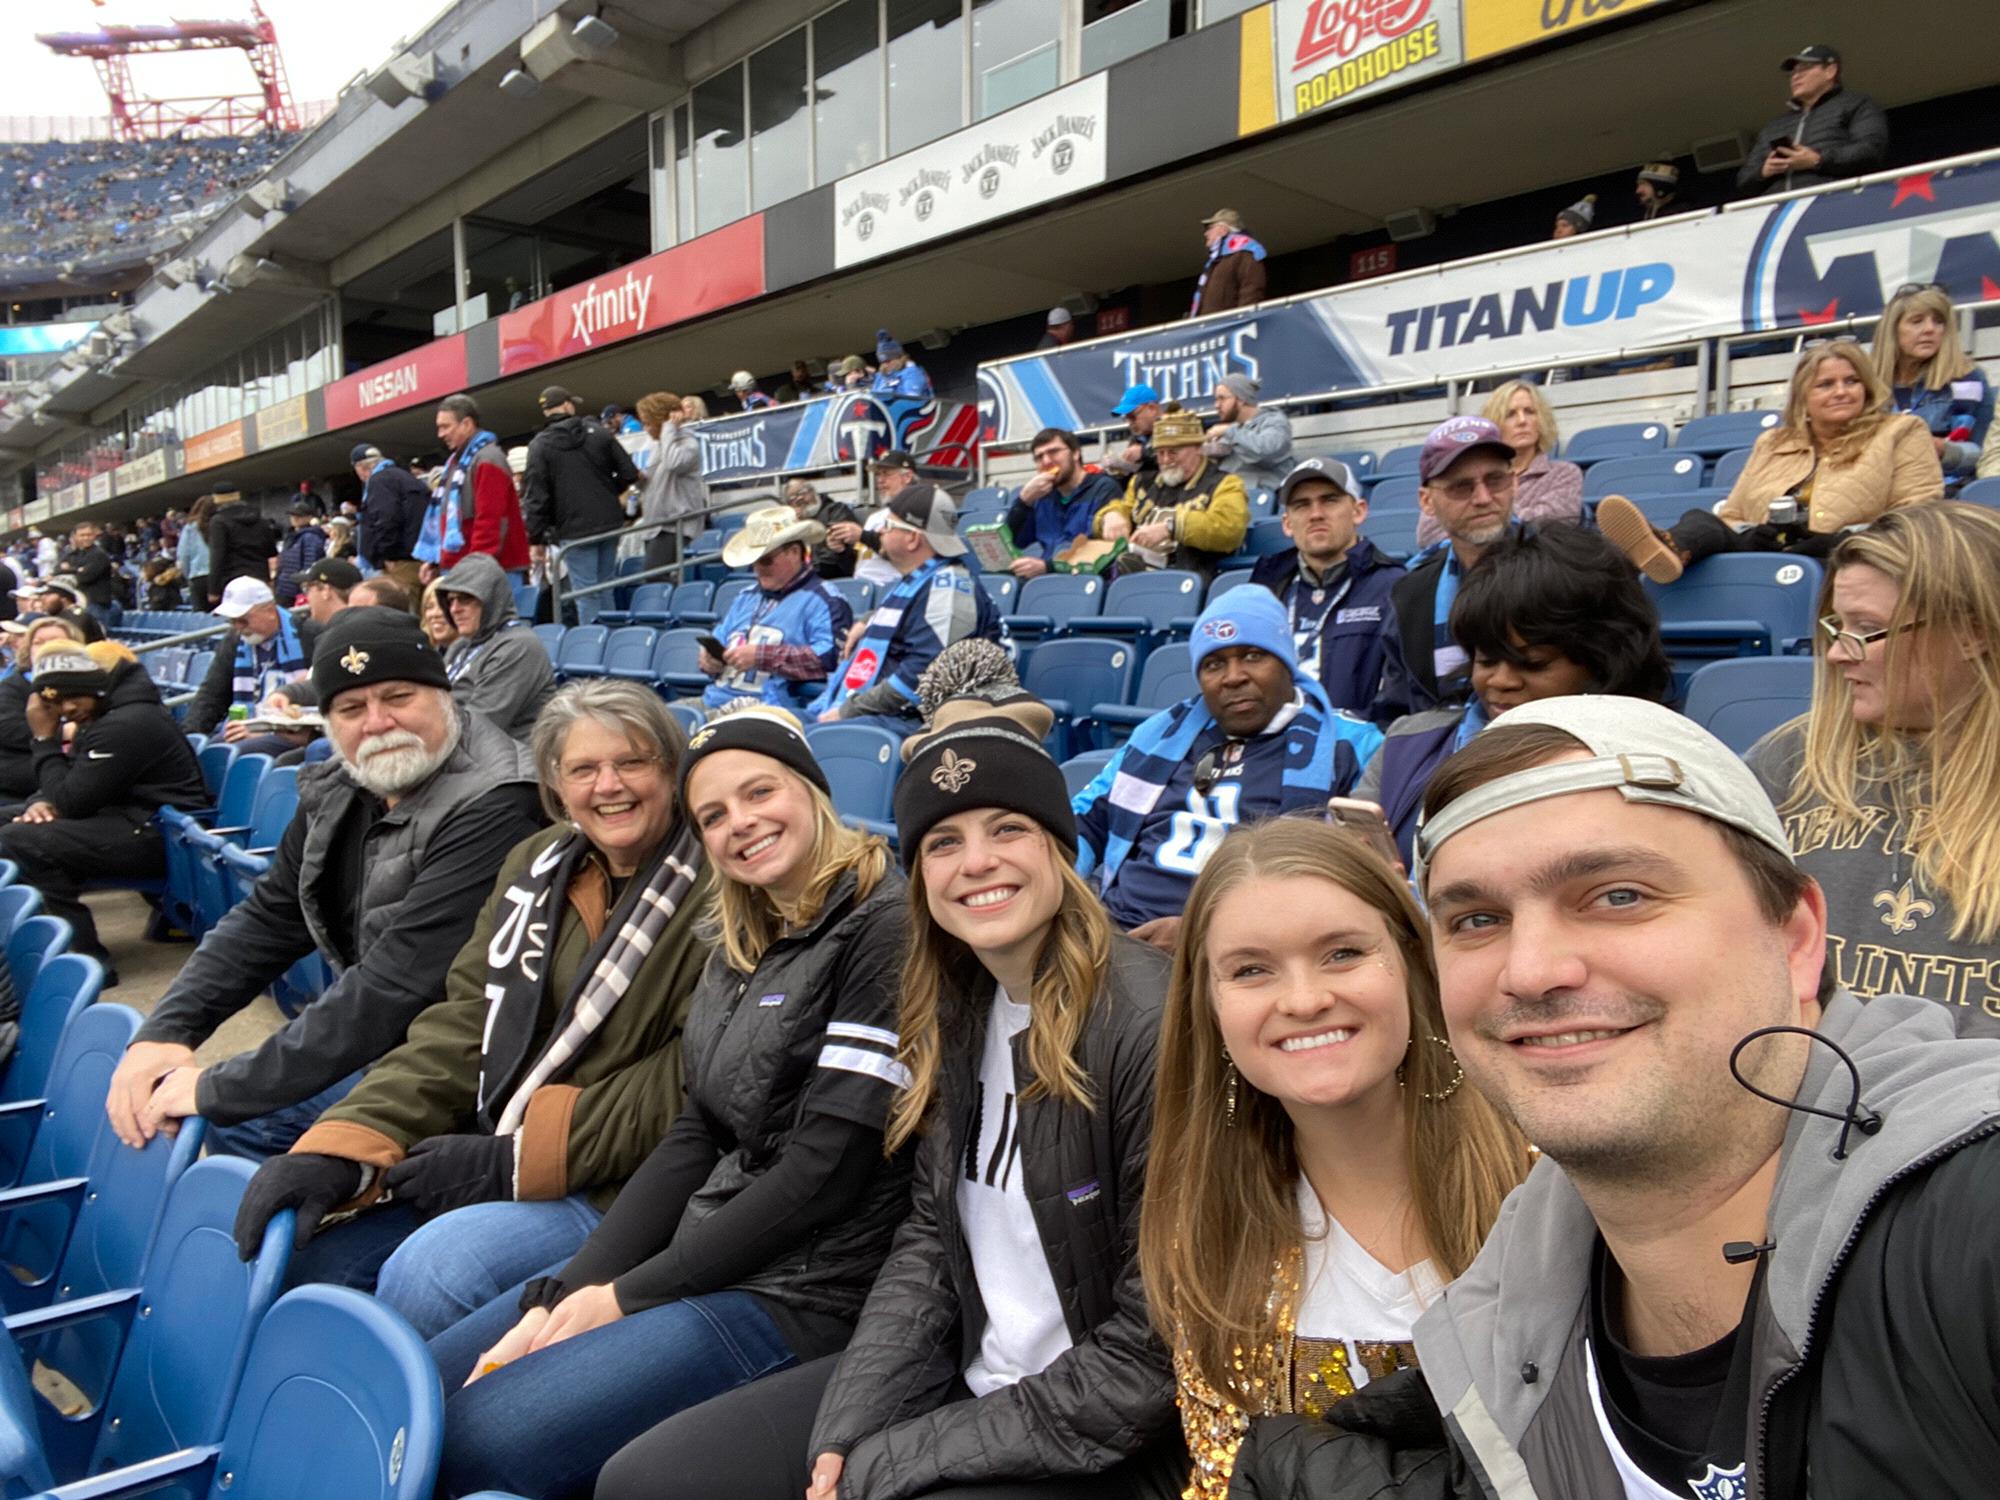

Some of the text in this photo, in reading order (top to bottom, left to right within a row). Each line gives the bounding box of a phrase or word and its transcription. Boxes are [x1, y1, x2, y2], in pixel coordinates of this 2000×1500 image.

[1295, 21, 1440, 114] ROADHOUSE
[1356, 252, 1390, 272] 115
[571, 271, 653, 346] xfinity
[1112, 321, 1262, 405] TITANS
[1145, 335, 1227, 361] TENNESSEE
[358, 364, 417, 408] NISSAN
[694, 420, 766, 476] TITANS
[1437, 420, 1490, 440] TITANS
[1784, 805, 1890, 857] NEW
